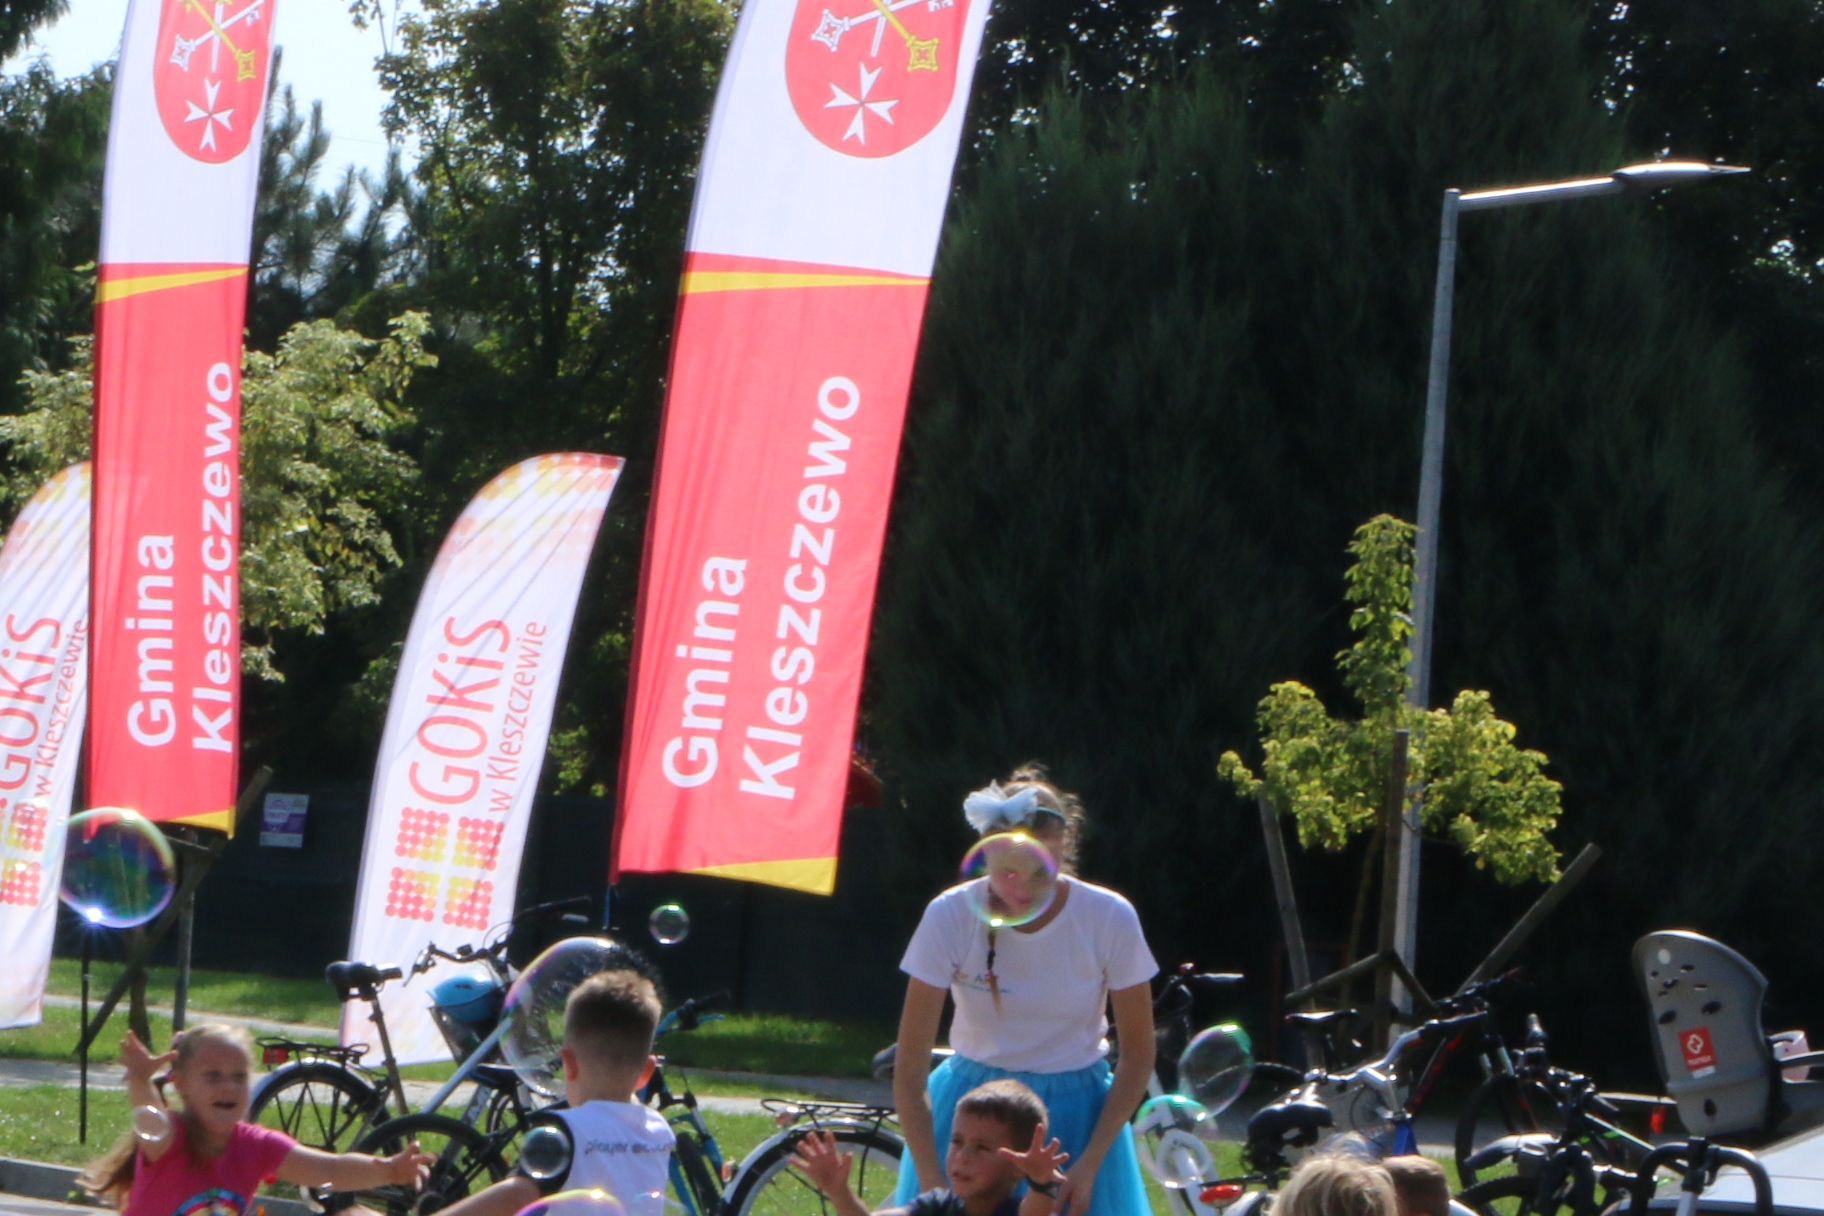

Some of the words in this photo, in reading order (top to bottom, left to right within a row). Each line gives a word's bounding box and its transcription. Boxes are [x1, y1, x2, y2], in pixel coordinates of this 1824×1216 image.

[125, 534, 177, 748] Gmina
[192, 361, 234, 753] Kleszczewo
[739, 375, 860, 800] Kleszczewo
[33, 619, 89, 768] Kleszczewie
[408, 616, 511, 806] GOKiS
[486, 621, 547, 781] Kleszczewie
[662, 556, 747, 789] Gmina
[33, 775, 52, 797] w
[488, 788, 513, 813] w
